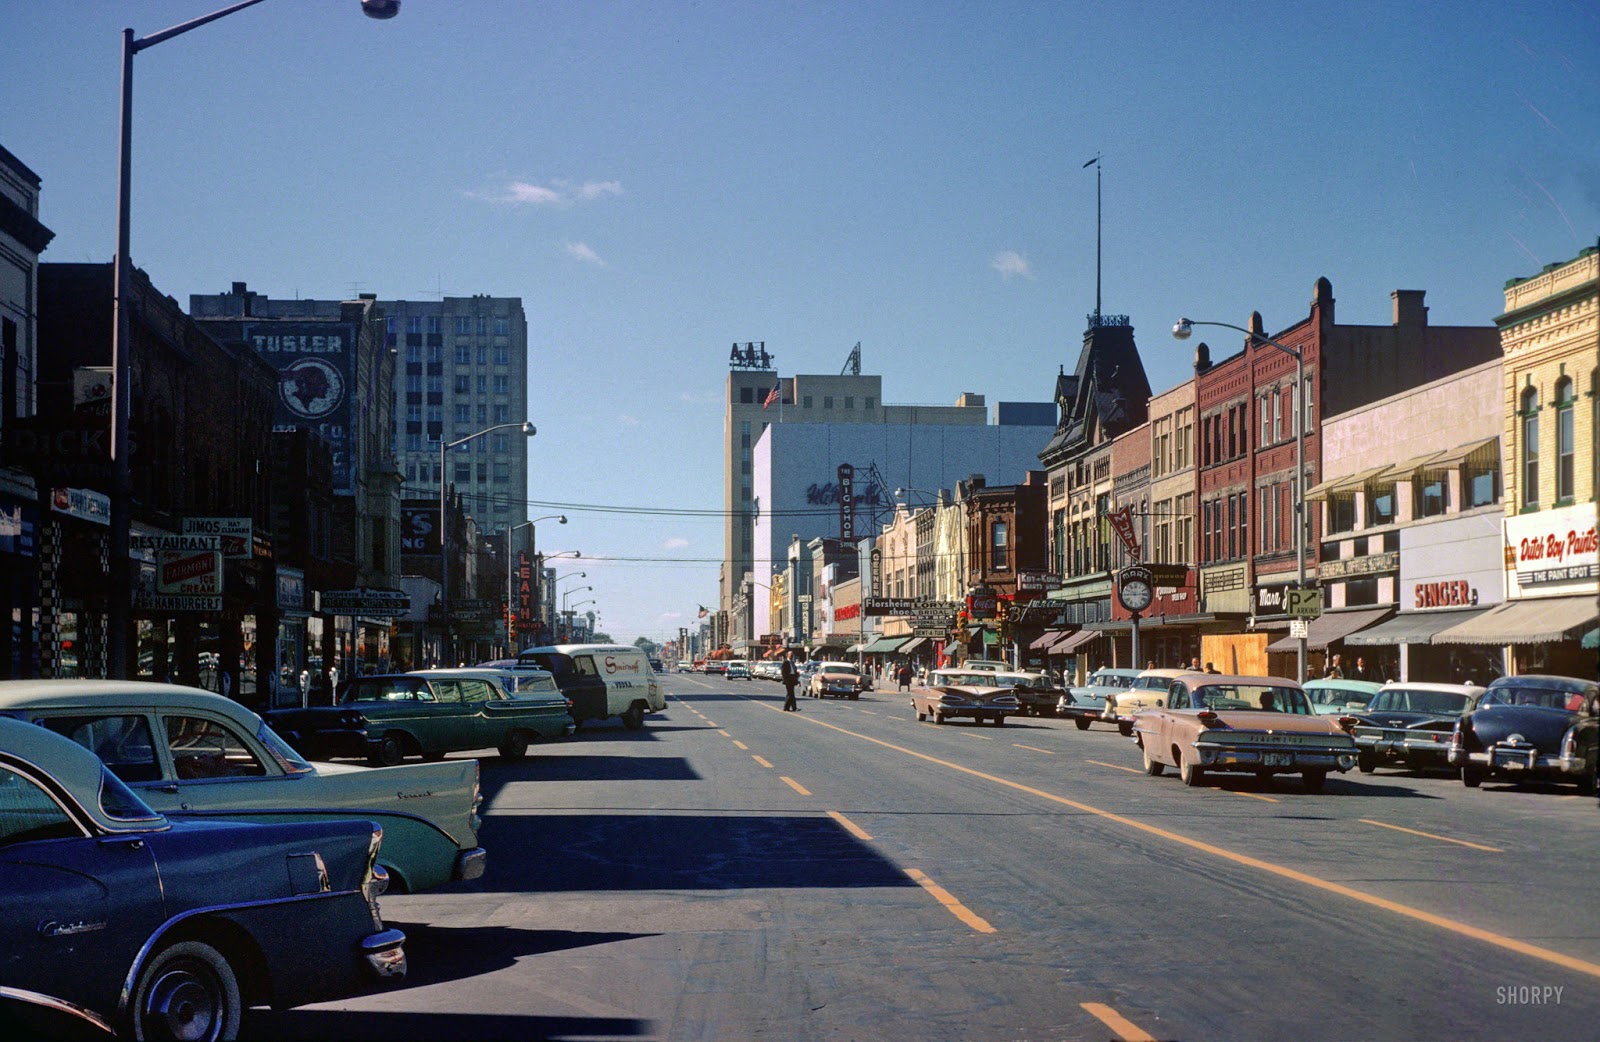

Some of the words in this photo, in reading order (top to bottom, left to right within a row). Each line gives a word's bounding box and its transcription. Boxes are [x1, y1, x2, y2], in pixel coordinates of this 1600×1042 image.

[252, 335, 342, 352] TUSLER
[1114, 513, 1139, 556] MUSIC
[130, 536, 218, 550] RESTAURANT
[1521, 537, 1544, 562] Dutch
[1547, 533, 1564, 563] Boy
[1567, 527, 1598, 556] Paints
[165, 558, 214, 578] FAIRMONT
[1534, 571, 1547, 582] THE
[1548, 569, 1567, 581] PAINT
[1568, 566, 1588, 579] SPOT
[520, 553, 531, 619] LEATH
[1153, 574, 1185, 583] gnavox
[180, 584, 215, 593] CREAM
[1415, 580, 1470, 609] SINGER
[155, 598, 220, 609] HAMBURGERS
[865, 598, 910, 608] Florsheim
